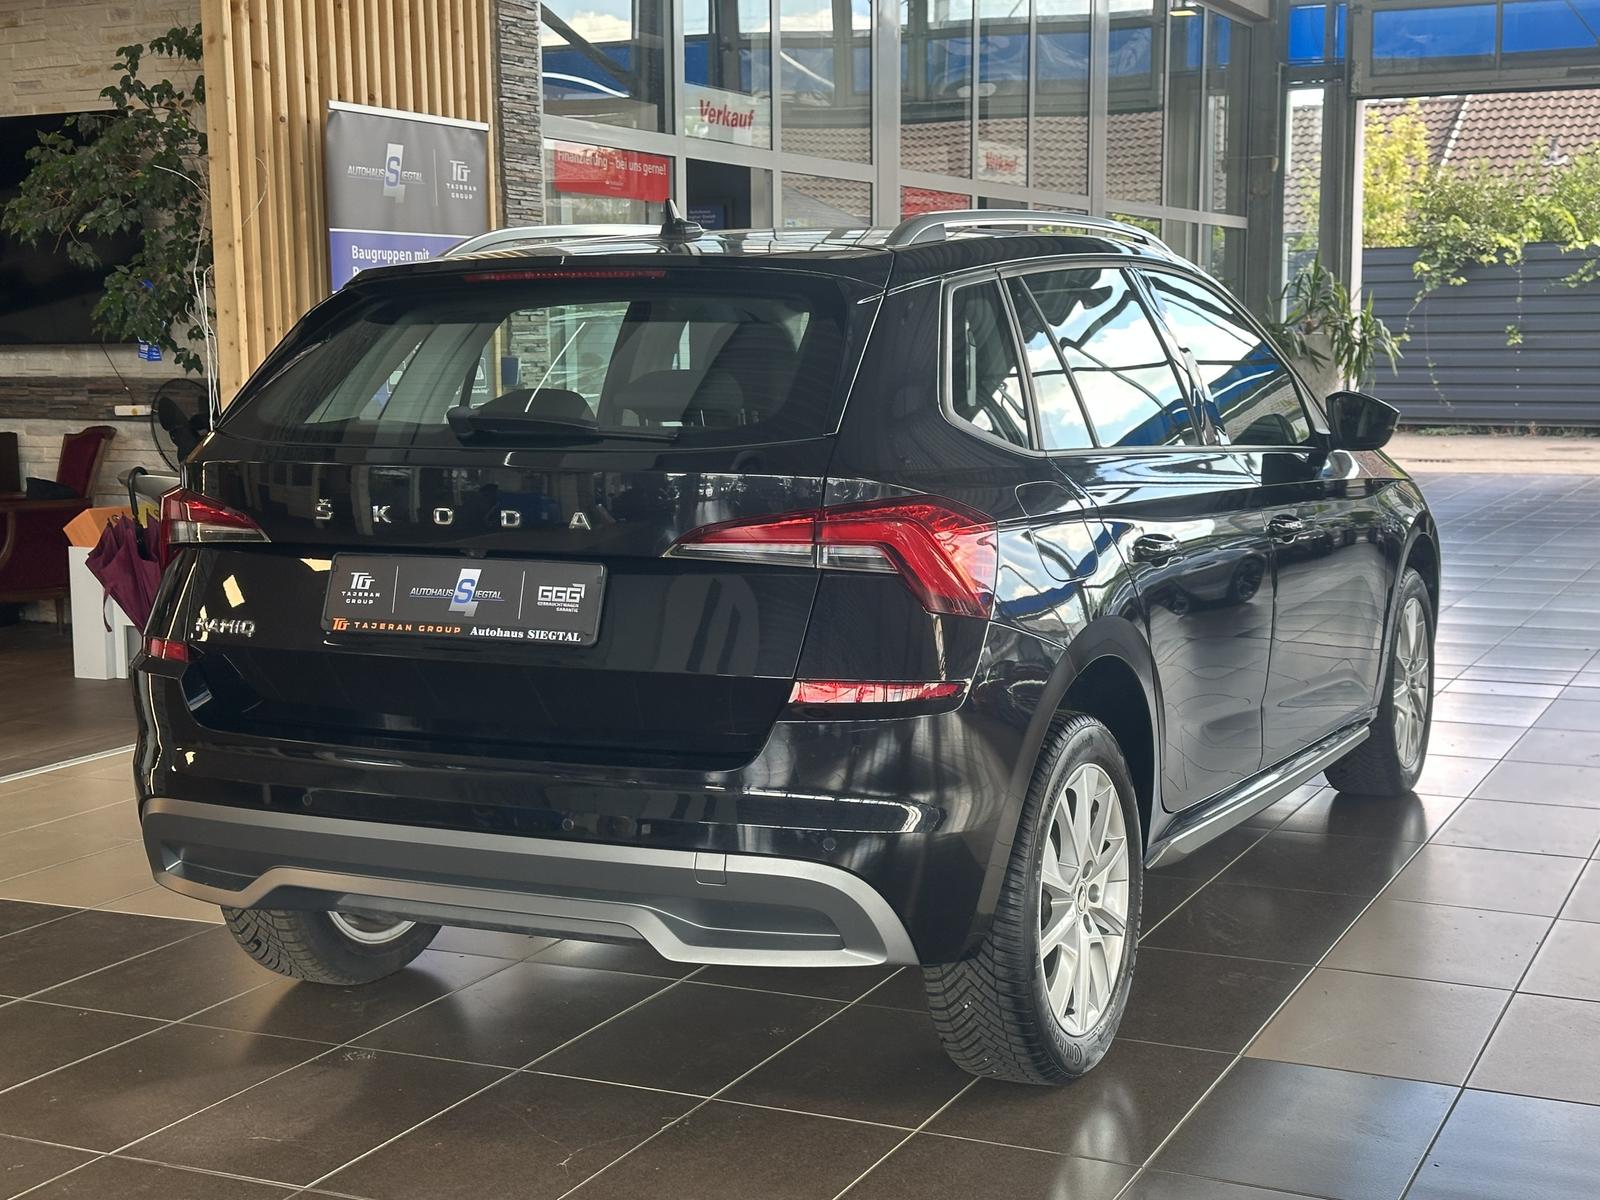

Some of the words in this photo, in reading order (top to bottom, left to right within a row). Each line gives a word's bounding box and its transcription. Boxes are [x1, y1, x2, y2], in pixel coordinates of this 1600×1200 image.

[699, 99, 755, 129] Verkauf
[347, 165, 385, 177] AUTOHAUS
[615, 156, 628, 169] bei
[629, 161, 642, 172] uns
[643, 163, 667, 176] gerne!
[351, 245, 412, 264] Baugruppen
[414, 248, 430, 260] mit
[315, 498, 591, 531] ŠKODA
[409, 587, 454, 597] AUTOHAUS
[538, 585, 581, 603] GGG
[354, 621, 412, 632] TAJERAN
[418, 625, 461, 634] GROUP
[470, 626, 524, 639] Autohaus
[527, 629, 581, 642] SIEGTAL
